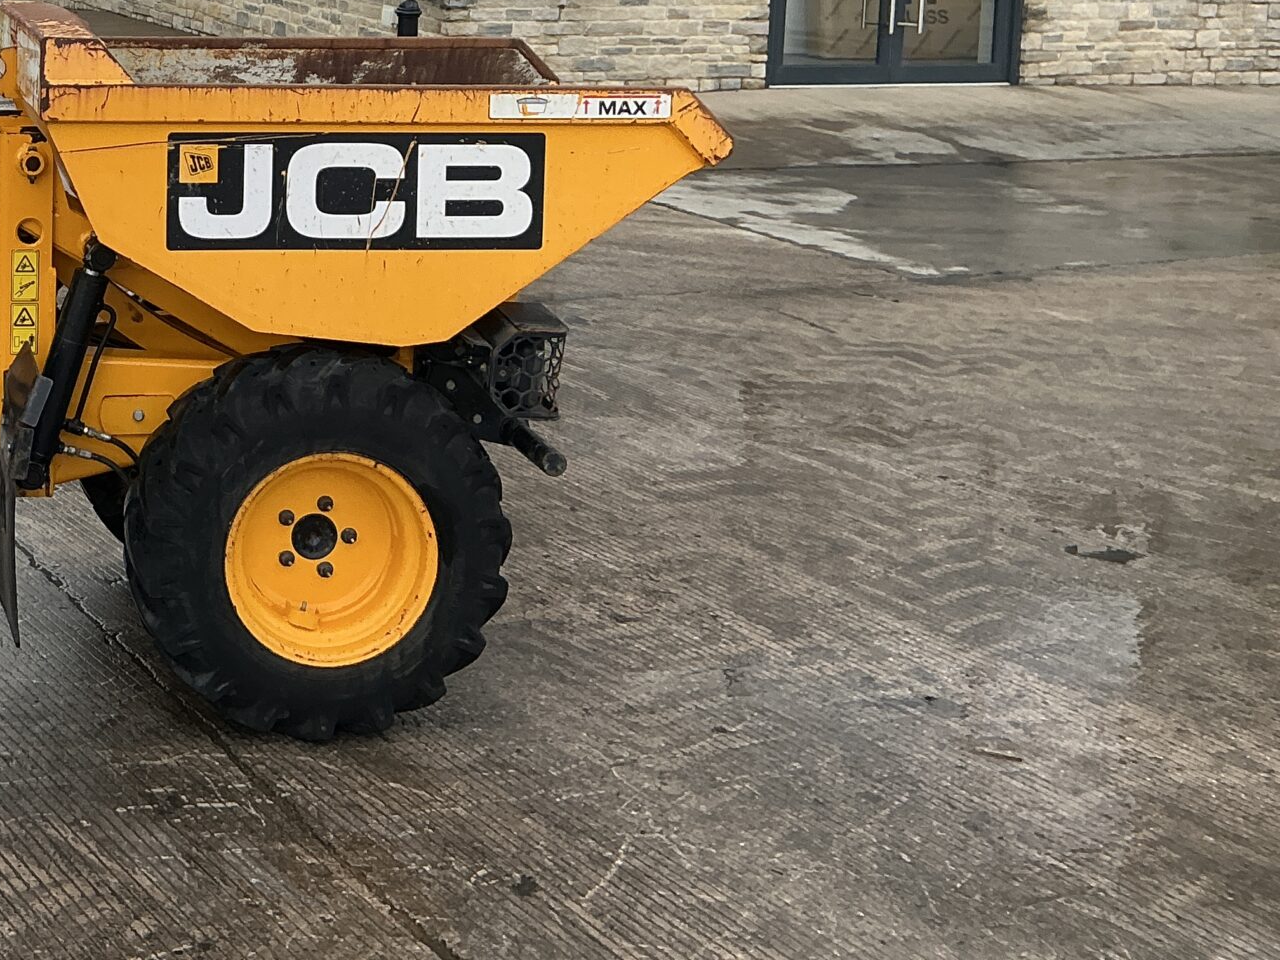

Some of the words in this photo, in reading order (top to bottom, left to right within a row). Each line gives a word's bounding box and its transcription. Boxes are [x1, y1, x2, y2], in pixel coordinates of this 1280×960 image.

[598, 100, 647, 116] MAX
[189, 154, 212, 173] JCB
[177, 141, 534, 240] JCB
